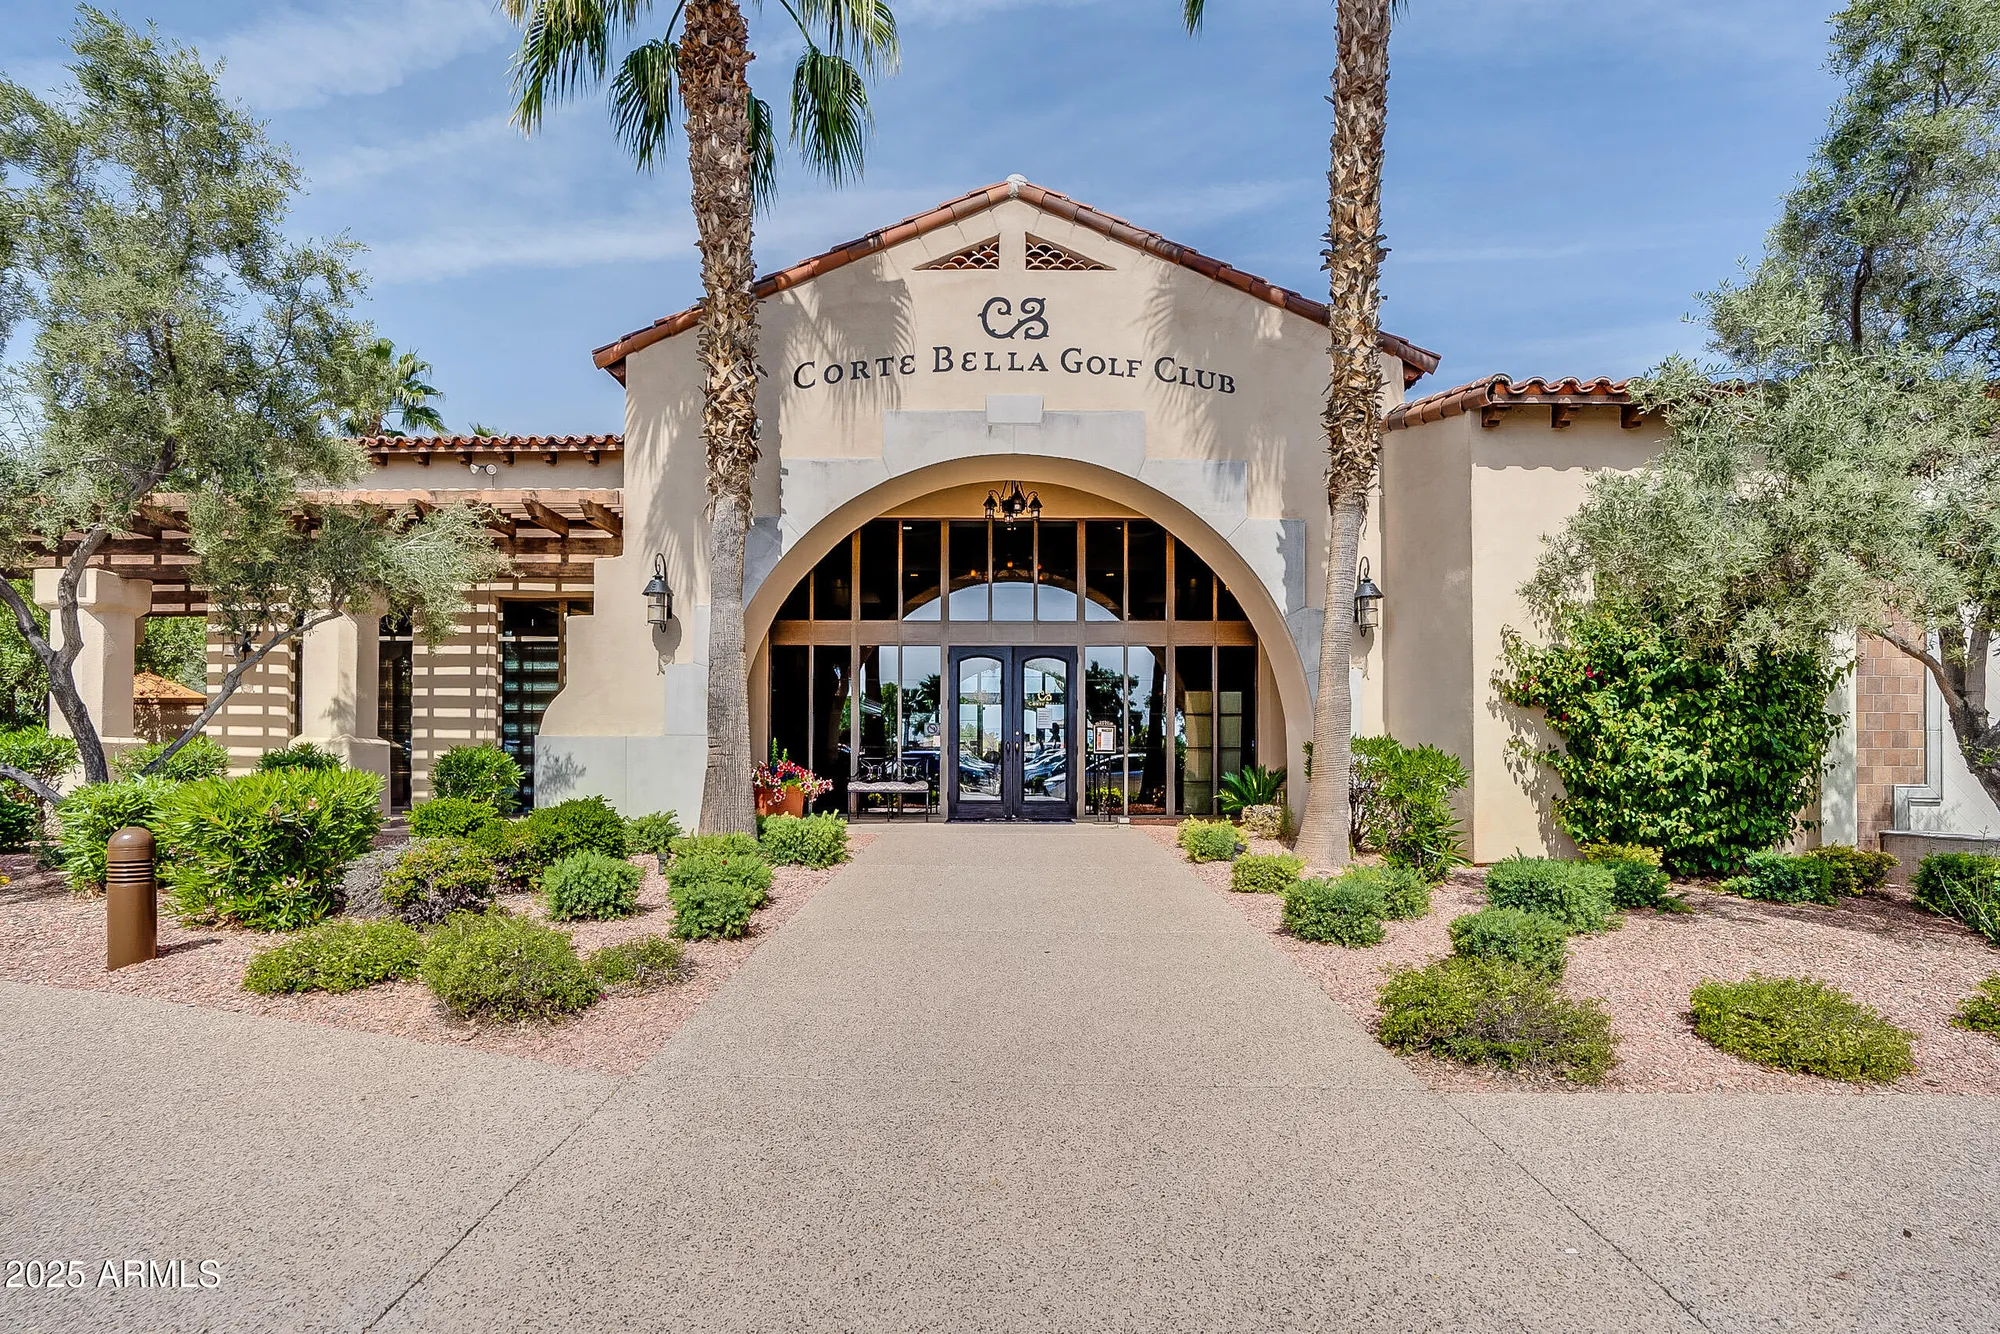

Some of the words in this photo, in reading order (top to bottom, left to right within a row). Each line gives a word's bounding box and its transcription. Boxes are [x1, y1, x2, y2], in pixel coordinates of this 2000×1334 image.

[793, 354, 916, 390] CORTE
[932, 345, 1049, 374] BELLA
[1060, 347, 1143, 379] GOLF
[1153, 356, 1237, 395] CLUB
